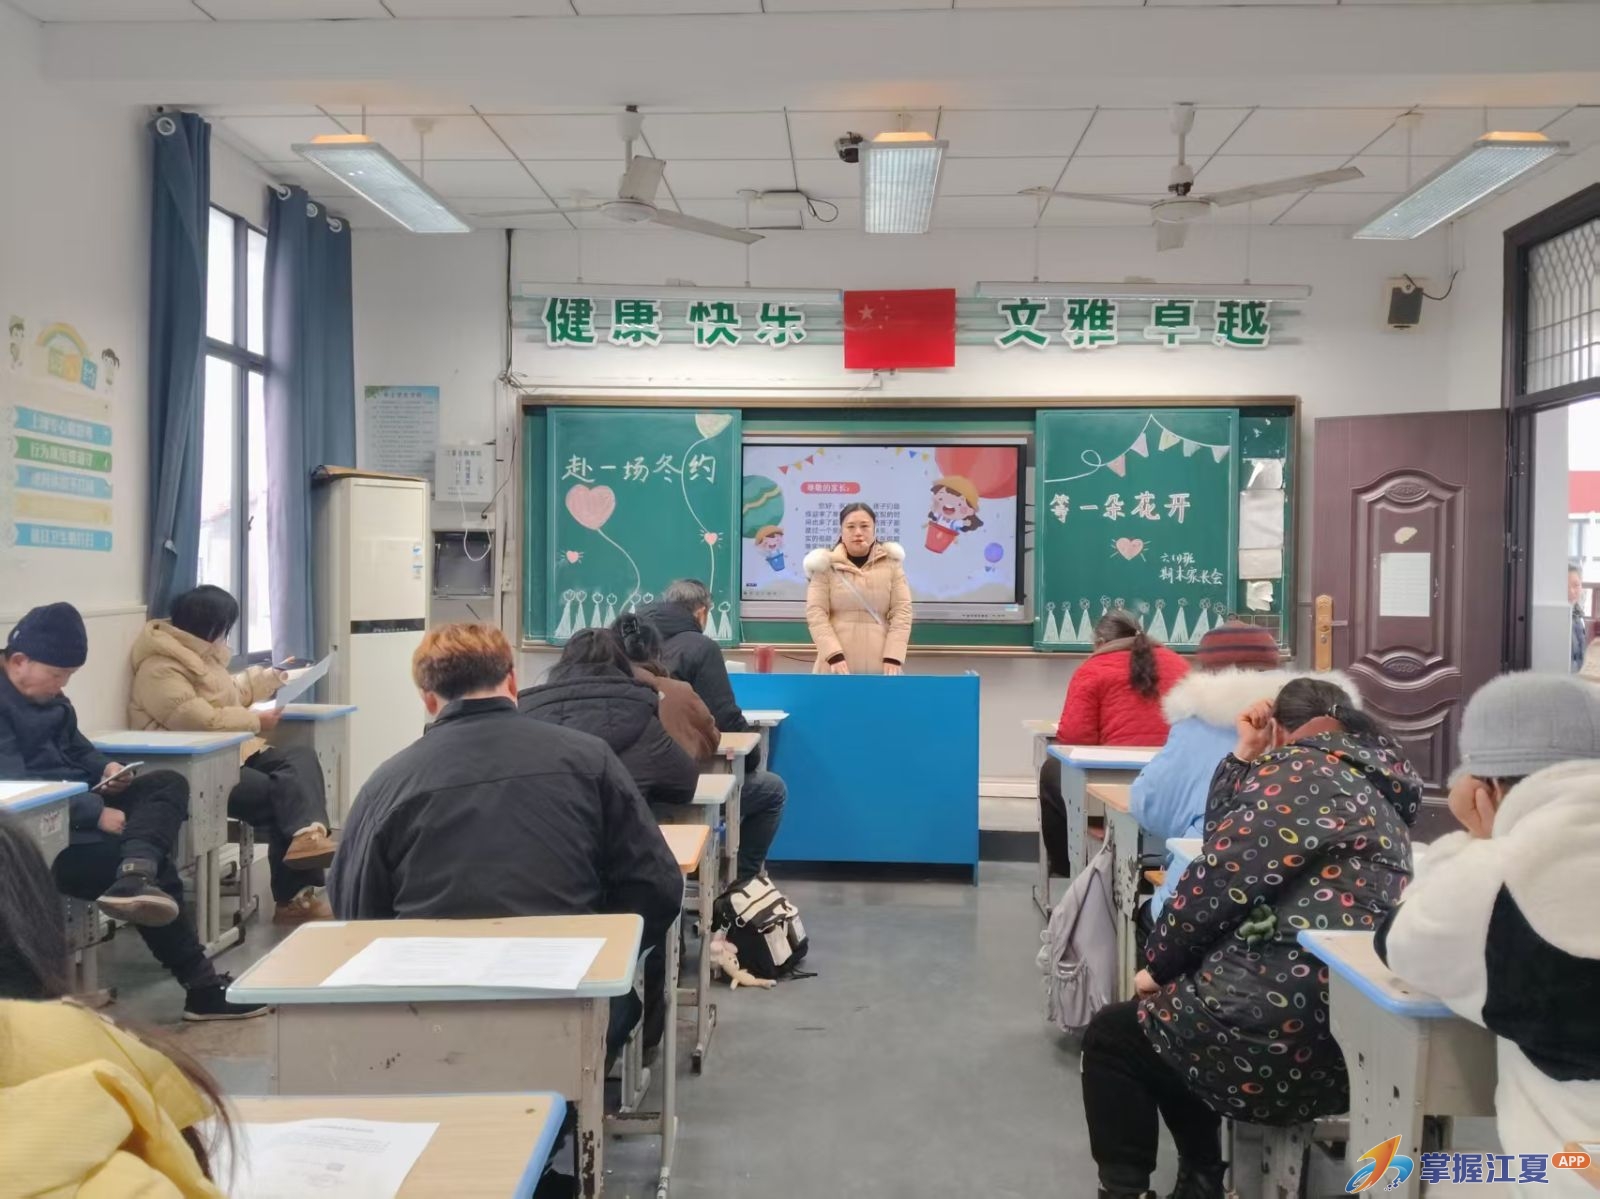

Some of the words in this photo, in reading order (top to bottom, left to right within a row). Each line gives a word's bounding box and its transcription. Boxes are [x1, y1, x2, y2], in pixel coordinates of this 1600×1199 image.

[562, 453, 717, 484] 赴一场冬约
[1049, 490, 1192, 524] 等一朵花开
